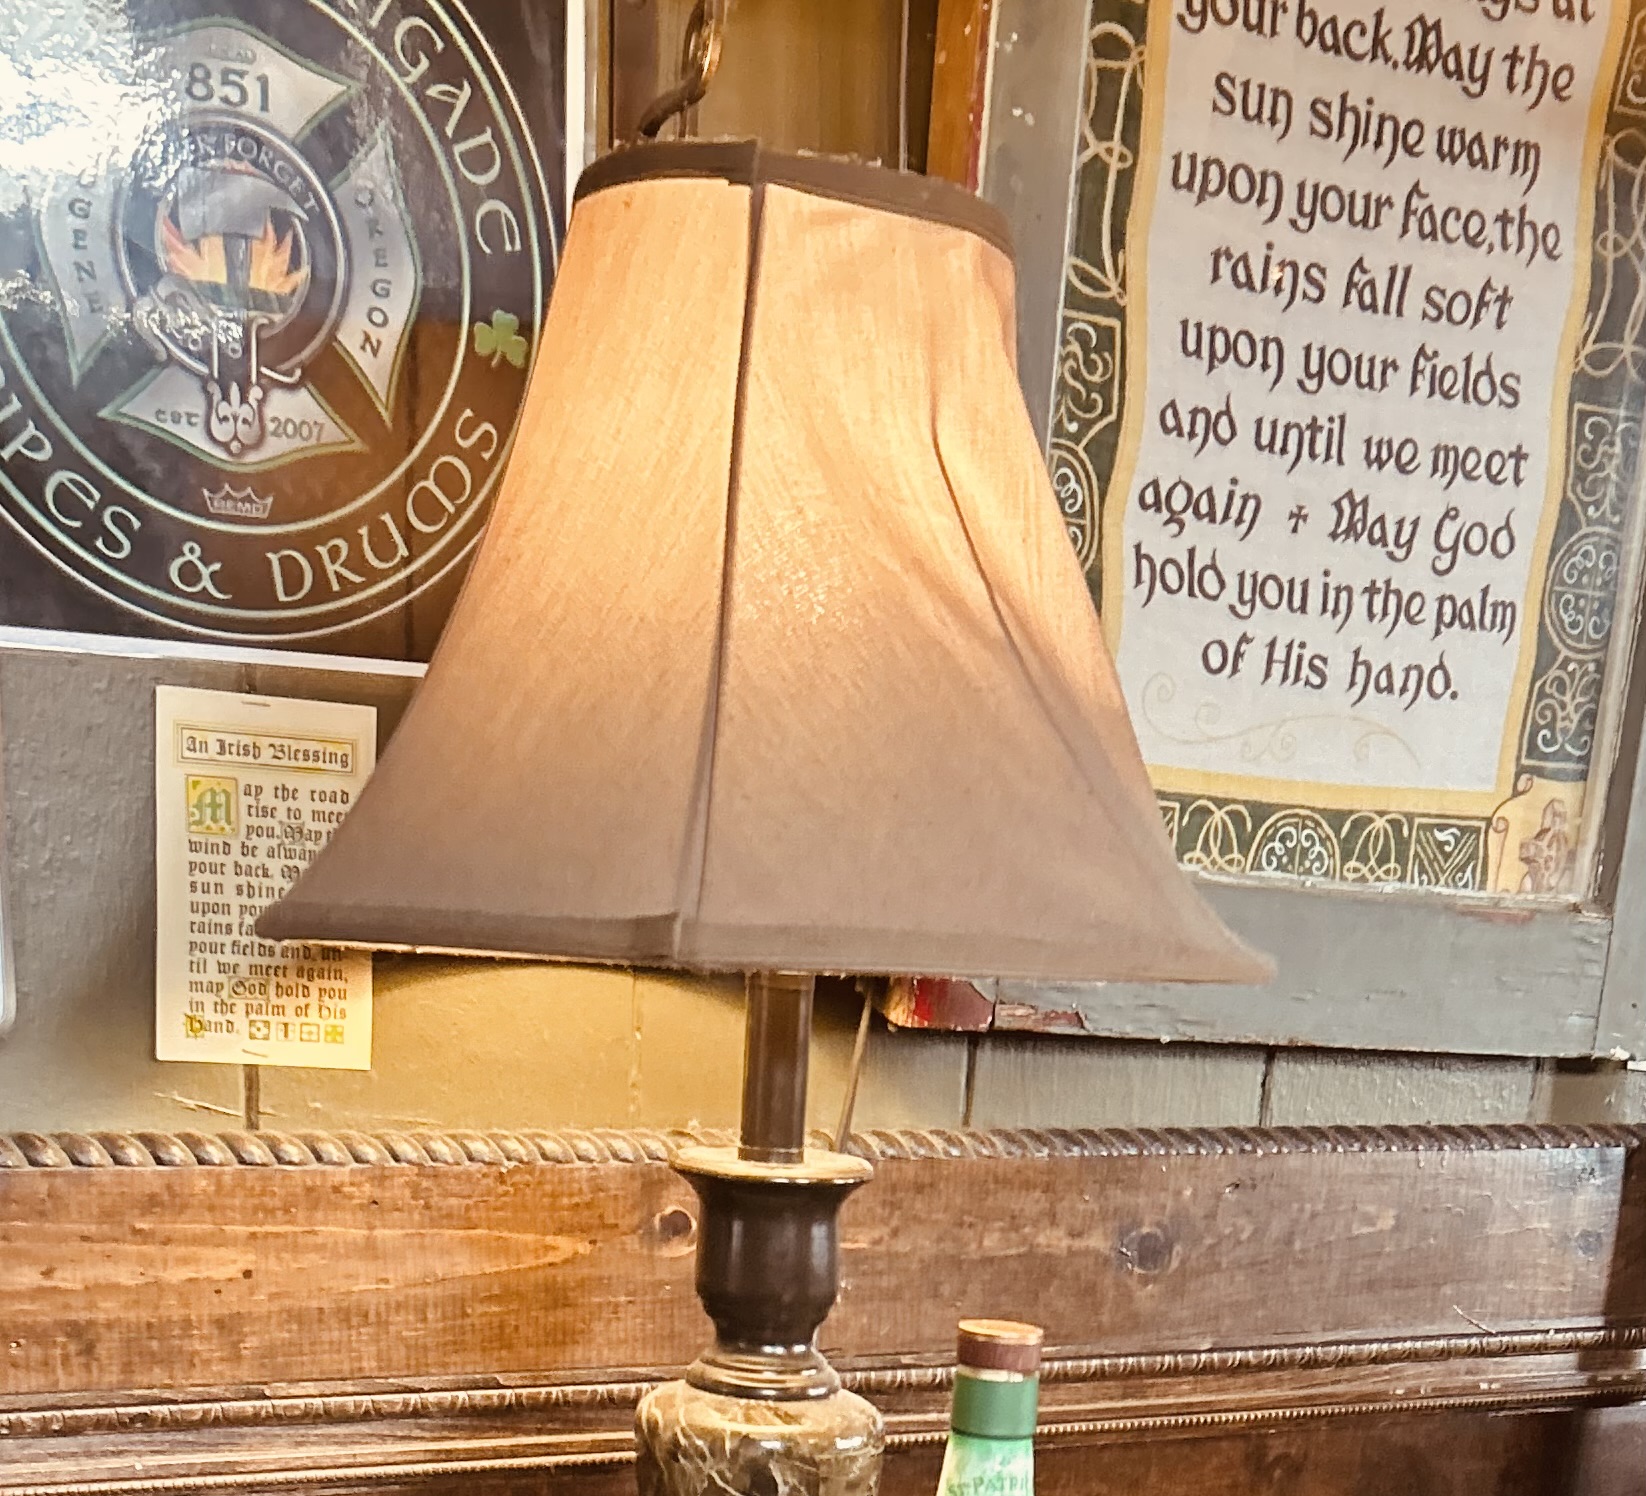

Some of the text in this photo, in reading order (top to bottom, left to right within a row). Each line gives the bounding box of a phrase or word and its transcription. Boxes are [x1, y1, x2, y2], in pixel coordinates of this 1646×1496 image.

[1176, 0, 1288, 33] your
[1502, 44, 1575, 111] the
[185, 62, 269, 113] 851
[367, 0, 522, 255] IGADE
[1212, 72, 1541, 196] sun shine warm
[1171, 149, 1284, 225] upon
[1289, 181, 1394, 233] your
[1210, 241, 1514, 331] rains fall soft
[1180, 316, 1521, 408] upon your fields
[269, 416, 326, 443] 2007
[1159, 392, 1529, 491] and until we meet
[170, 541, 232, 601] &
[266, 408, 498, 604] DRUMS
[1138, 475, 1516, 577] again May God
[1133, 541, 1517, 646] hold you in the palm
[1202, 631, 1459, 712] of His hand.
[186, 736, 349, 769] An Irish Blessing
[274, 783, 299, 801] the
[310, 789, 349, 804] road
[247, 800, 347, 824] rise to mee
[188, 839, 231, 855] wind
[240, 841, 258, 858] be
[188, 860, 226, 876] your
[189, 880, 286, 899] sun shine
[190, 901, 231, 918] upon
[190, 919, 233, 935] rains
[188, 940, 226, 956] your
[231, 939, 276, 957] fields
[189, 957, 349, 983] til we meet again,
[188, 980, 347, 1004] may God hold you
[188, 999, 347, 1020] in the palm of His
